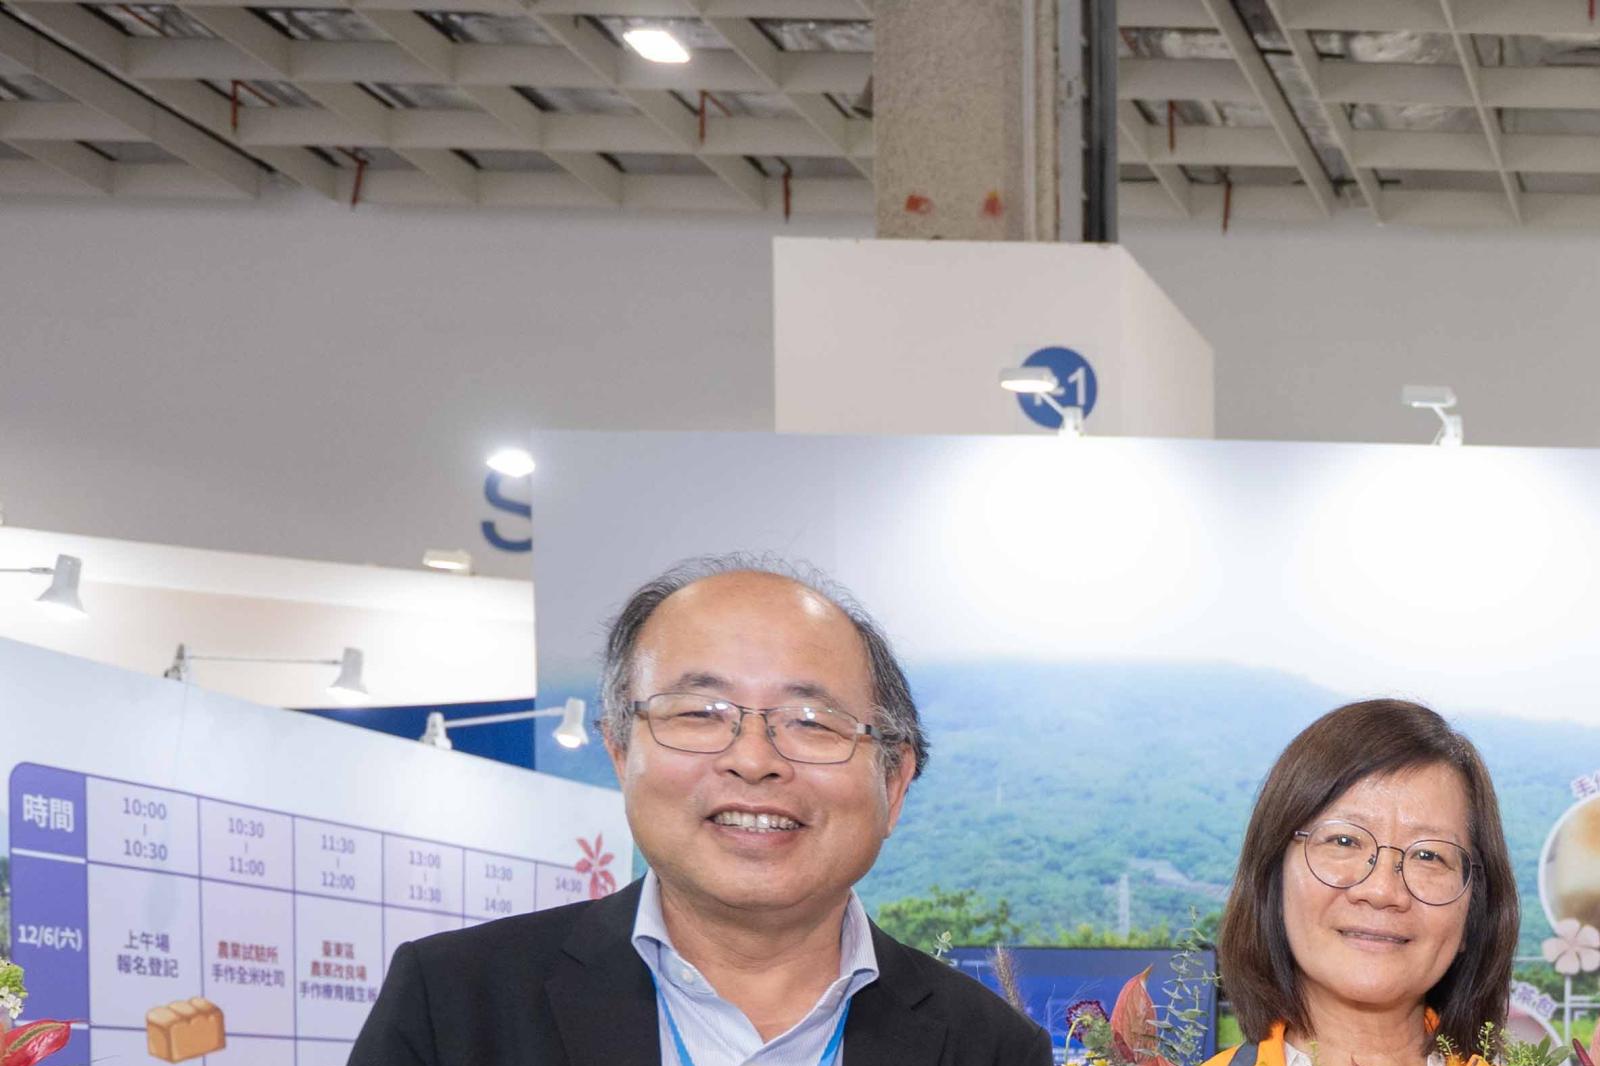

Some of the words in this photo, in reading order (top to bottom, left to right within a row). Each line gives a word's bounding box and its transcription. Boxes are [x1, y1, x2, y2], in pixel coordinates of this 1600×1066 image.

[22, 793, 75, 833] 時間
[123, 798, 167, 820] 10:00
[228, 817, 265, 839] 10:30
[124, 839, 168, 862] 10:30
[321, 834, 355, 855] 11:30
[229, 856, 265, 877] 11:00
[409, 850, 441, 869] 13:00
[321, 871, 355, 891] 12:00
[409, 885, 441, 904] 13:30
[18, 924, 83, 951] 12/6(六)
[117, 953, 179, 979] 報名登記
[211, 963, 285, 988] 手作全米吐司
